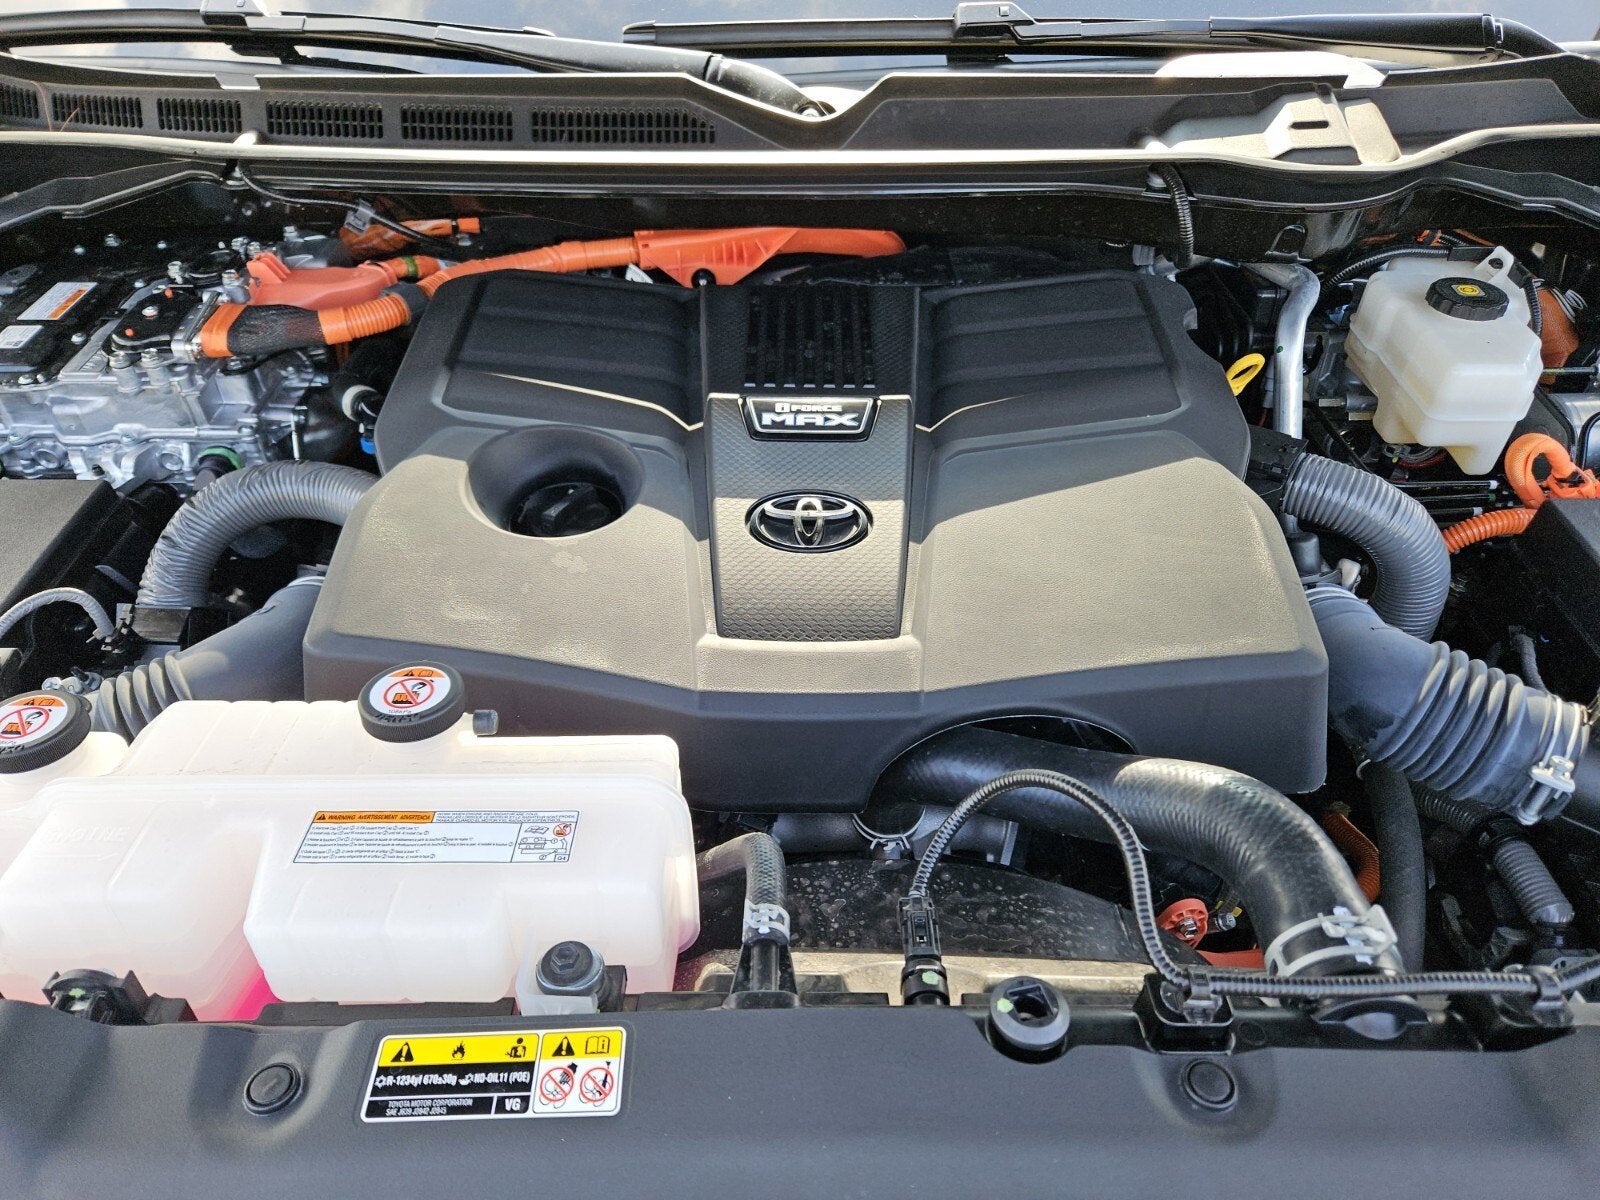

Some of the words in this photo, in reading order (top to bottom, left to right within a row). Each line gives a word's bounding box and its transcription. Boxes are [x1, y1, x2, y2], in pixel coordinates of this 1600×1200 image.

[761, 413, 859, 426] MAX
[509, 1071, 530, 1085] (POE)
[388, 1100, 410, 1108] TOYOTA
[410, 1099, 432, 1107] MOTOR
[432, 1098, 473, 1107] CORPORATION
[504, 1098, 521, 1111] VG
